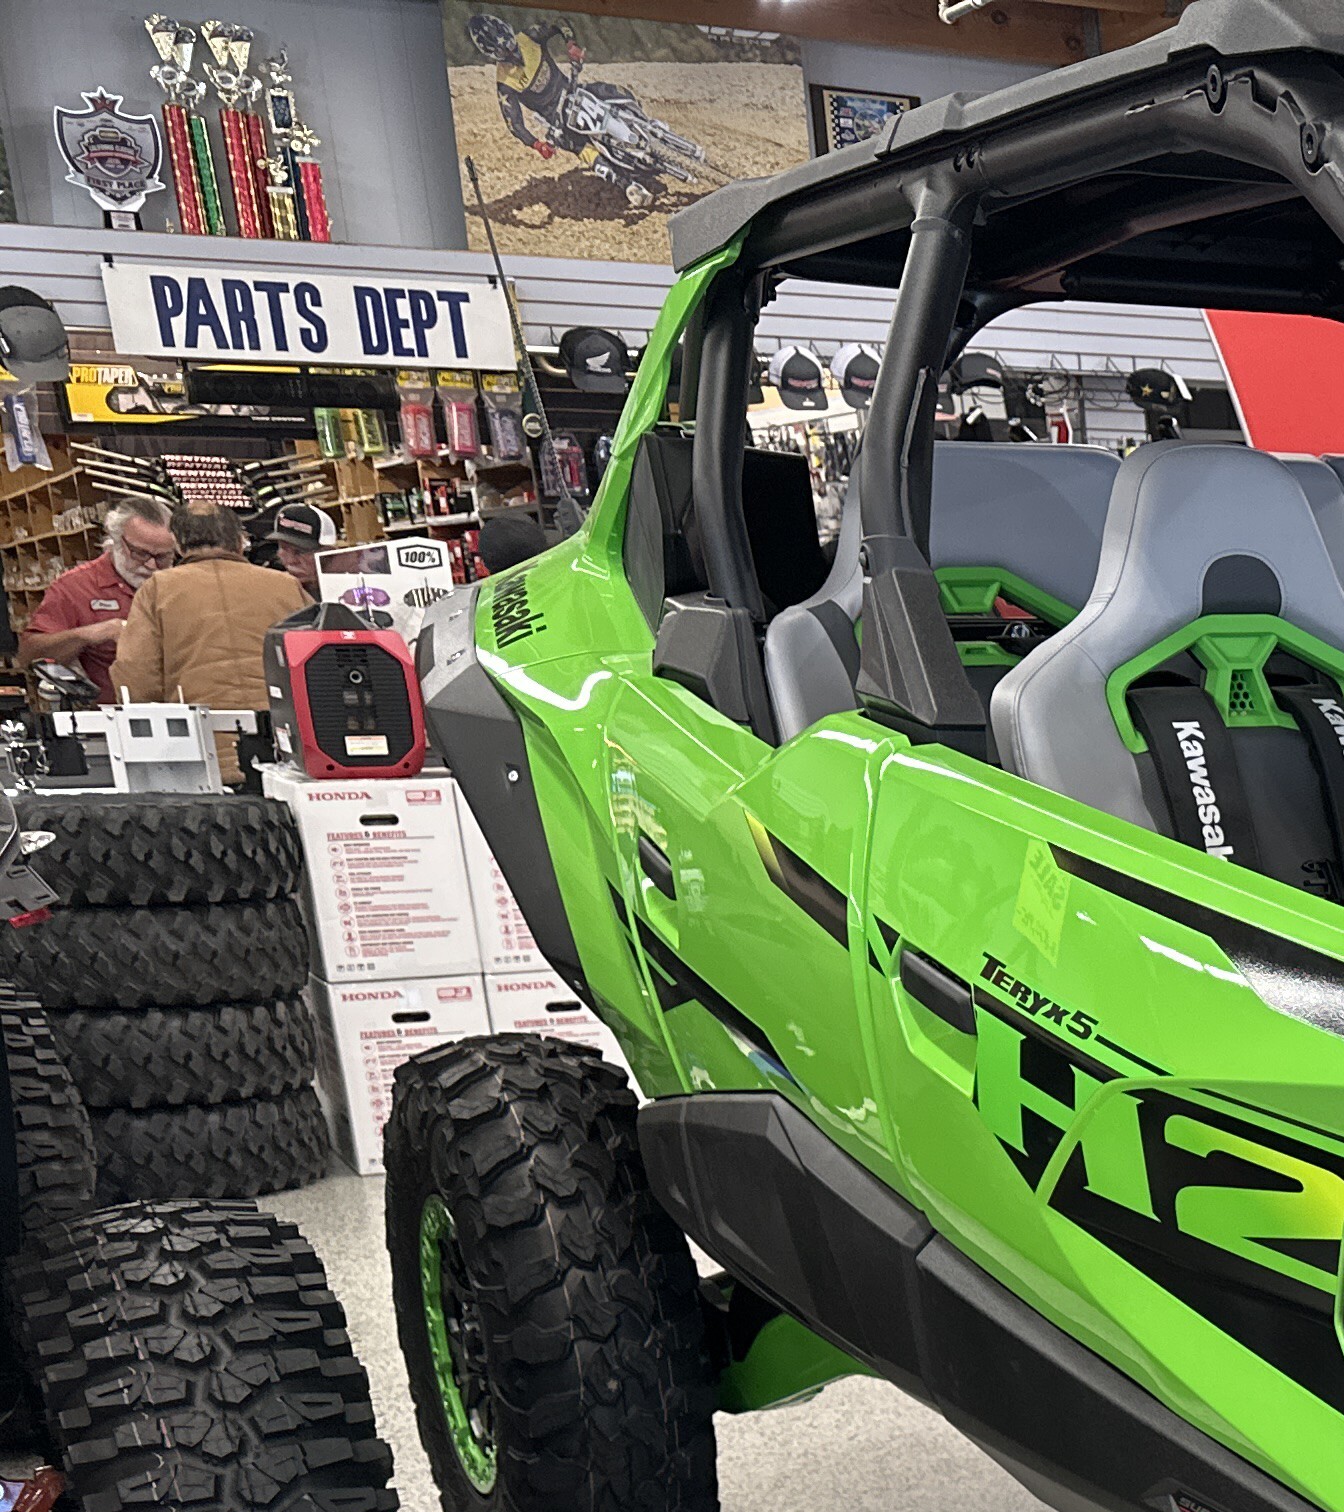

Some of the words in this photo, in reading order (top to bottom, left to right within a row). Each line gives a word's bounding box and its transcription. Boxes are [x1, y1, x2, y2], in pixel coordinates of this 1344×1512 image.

[577, 97, 605, 131] 24
[149, 274, 329, 353] PARTS
[353, 285, 471, 359] DEPT
[71, 365, 135, 386] PROTAPER
[403, 551, 436, 564] 100%
[307, 792, 372, 801] HONDA
[1172, 721, 1234, 862] Kawasak
[341, 989, 403, 1001] HONDA
[497, 980, 556, 993] HONDA
